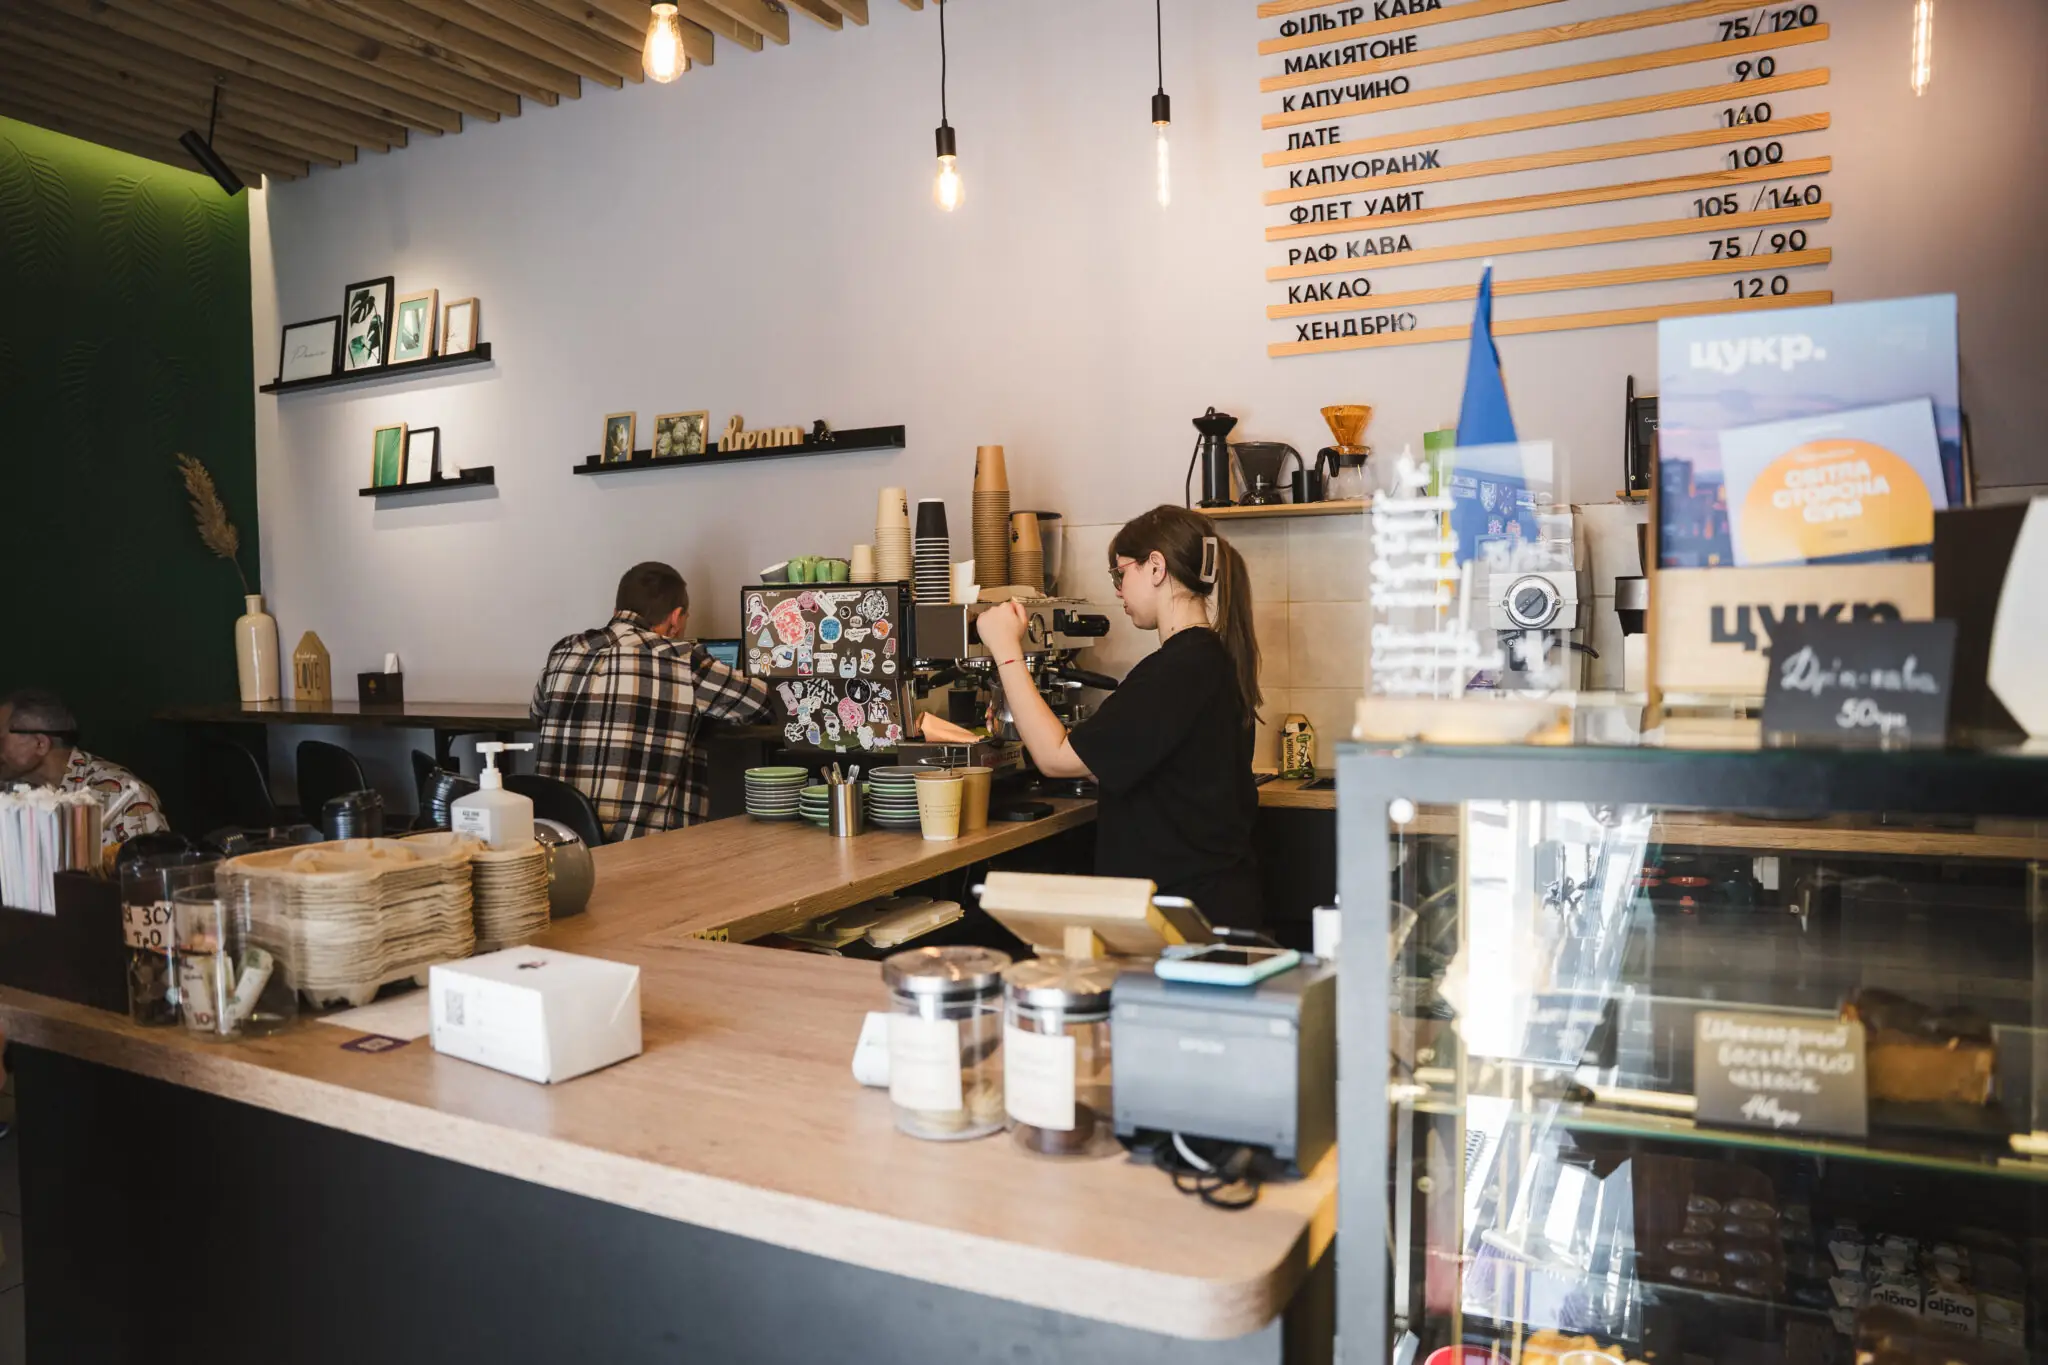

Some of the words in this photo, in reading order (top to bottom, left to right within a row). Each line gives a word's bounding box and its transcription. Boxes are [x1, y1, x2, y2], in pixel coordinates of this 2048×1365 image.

[1279, 6, 1364, 37] ФІЛЬТР
[1284, 35, 1418, 75] МАКІЯТОНЕ
[1735, 56, 1776, 82] 90
[1282, 76, 1410, 113] КАПУЧИНО
[1723, 102, 1772, 127] 140
[1286, 126, 1340, 151] ЛАТЕ
[1289, 149, 1441, 188] КАПУОРАНЖ
[1728, 141, 1783, 169] 100
[1289, 201, 1352, 224] ФЛЕТ
[1364, 191, 1424, 216] УАЙТ
[1288, 243, 1337, 266] РАФ
[1346, 234, 1413, 259] КАВА
[1288, 278, 1371, 304] КАКАО
[1733, 275, 1789, 299] 120
[717, 415, 804, 452] dream
[1927, 1296, 1975, 1318] alpro
